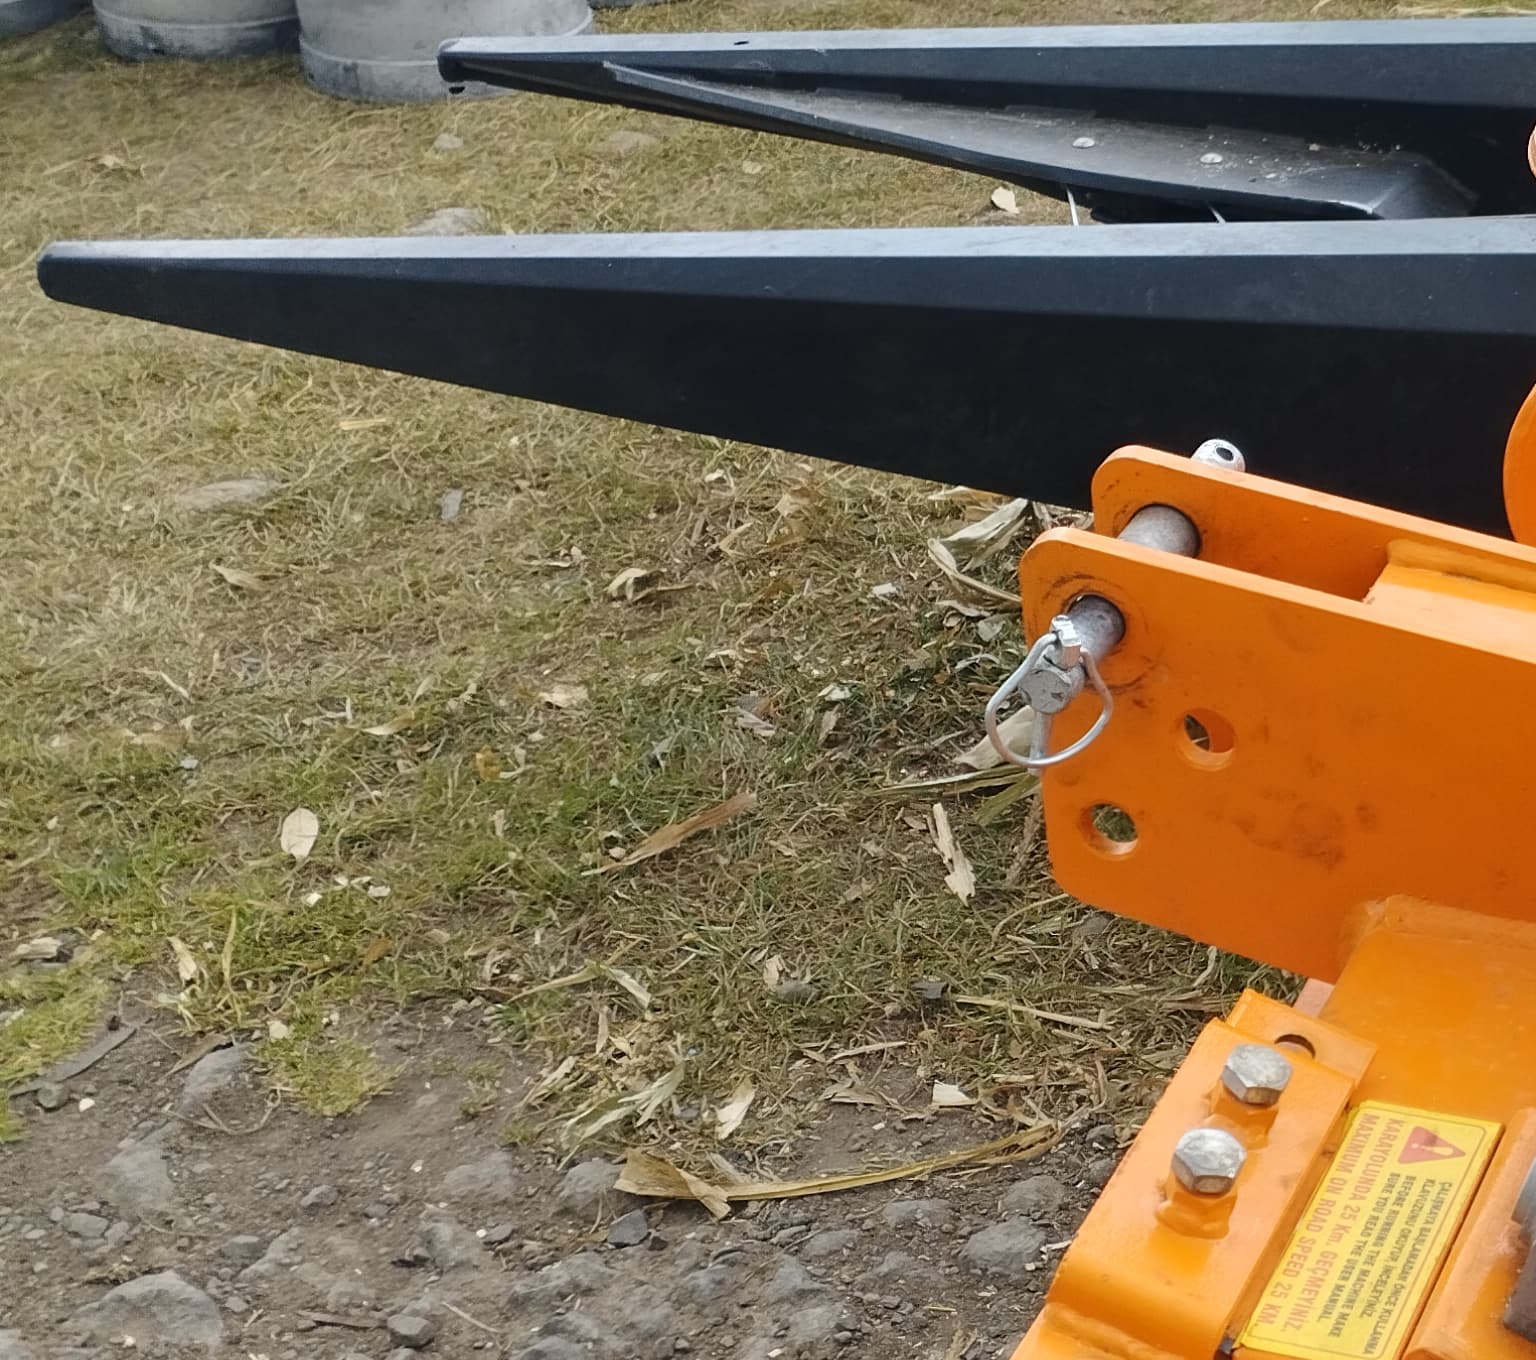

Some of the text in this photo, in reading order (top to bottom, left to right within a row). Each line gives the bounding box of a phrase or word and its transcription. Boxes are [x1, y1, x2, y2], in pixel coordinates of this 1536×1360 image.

[1336, 1114, 1379, 1173] MAXIMUM
[1350, 1119, 1403, 1200] KARAYOLUNDA
[1325, 1177, 1346, 1194] ON
[1381, 1172, 1400, 1194] SURE
[1392, 1175, 1416, 1207] BEFORE
[1306, 1198, 1336, 1232] ROAD
[1340, 1204, 1360, 1221] 25
[1372, 1196, 1389, 1213] YOU
[1360, 1214, 1379, 1237] READ
[1282, 1236, 1315, 1277] SPEED
[1350, 1240, 1368, 1256] THE
[1362, 1250, 1380, 1266] THE
[1337, 1258, 1358, 1281] USER
[1270, 1281, 1292, 1298] 25
[1341, 1268, 1370, 1310] MACHINE
[1328, 1312, 1350, 1337] MAKE
